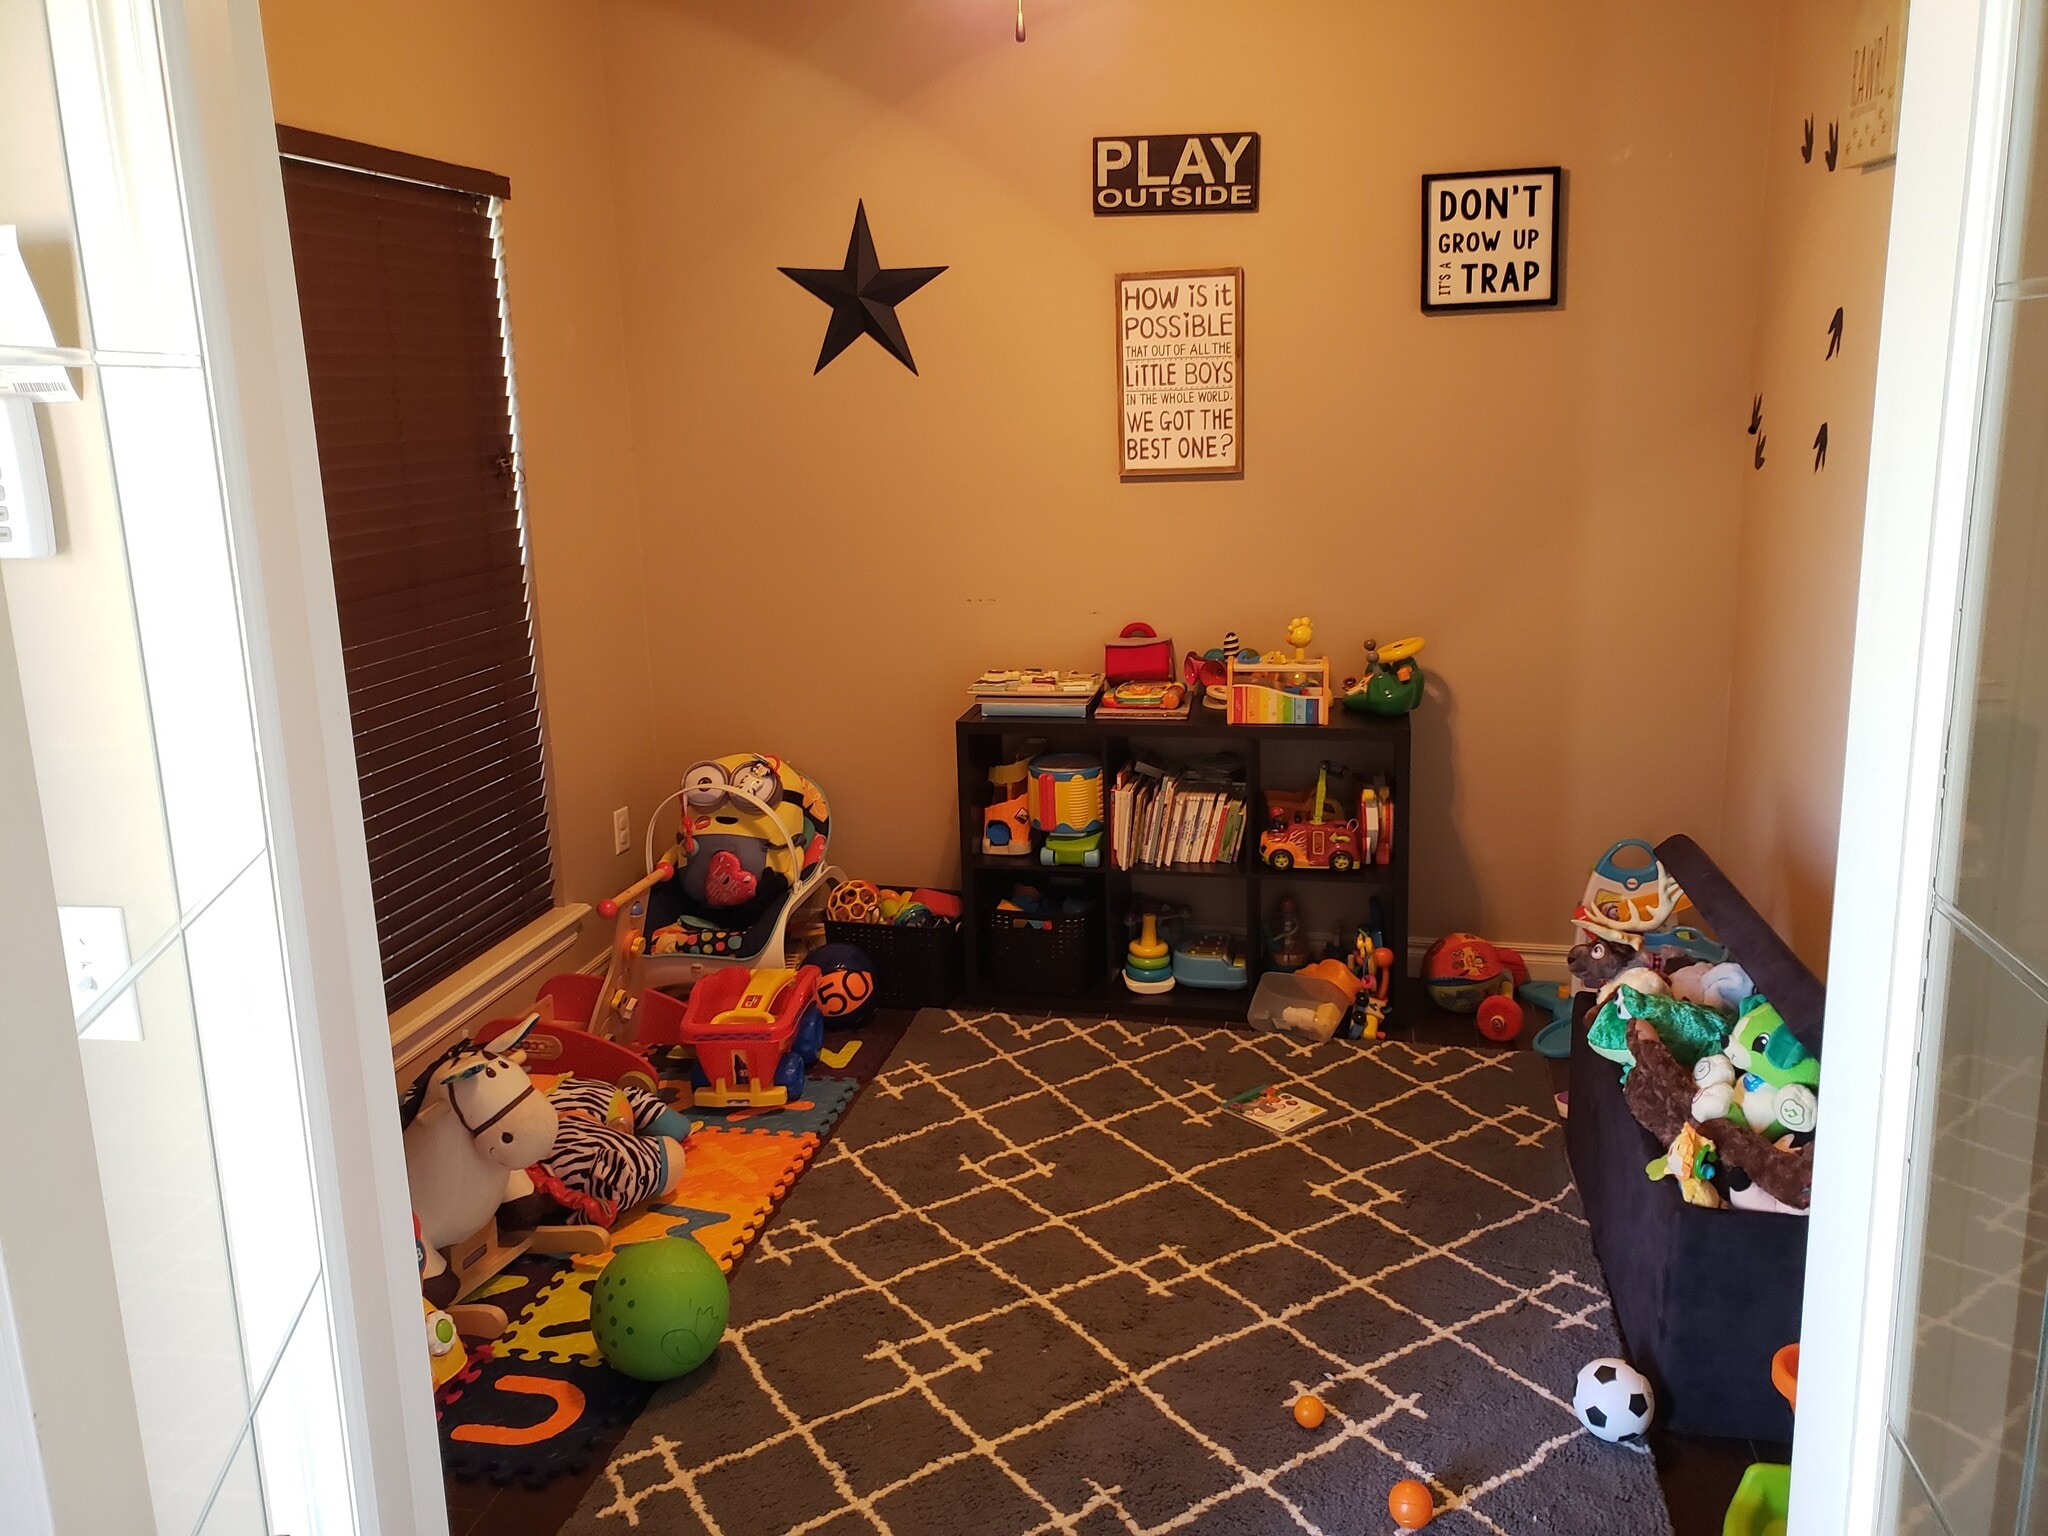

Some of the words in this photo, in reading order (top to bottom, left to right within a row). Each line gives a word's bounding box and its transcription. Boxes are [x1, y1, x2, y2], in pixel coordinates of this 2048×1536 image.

[1097, 135, 1253, 187] PLAY
[1097, 185, 1252, 208] OUTSIDE
[1440, 184, 1543, 222] DON'T
[1438, 230, 1501, 254] GROW
[1513, 229, 1540, 250] UP
[1438, 273, 1451, 296] IT'S
[1461, 261, 1540, 294] TRAP
[1124, 285, 1179, 311] HOW
[1125, 345, 1148, 358] THAT
[1151, 344, 1171, 357] OUT
[1173, 343, 1186, 356] OF
[1190, 342, 1210, 356] ALL
[1212, 341, 1232, 355] THE
[1185, 361, 1233, 385] BOYS
[1126, 394, 1136, 406] IN
[1140, 393, 1158, 405] THE
[1160, 391, 1194, 405] WHOLE
[1127, 411, 1154, 433] WE
[1160, 410, 1195, 431] GOT
[1200, 408, 1233, 430] THE
[1127, 437, 1172, 460] BEST
[1178, 433, 1234, 459] ONE?
[711, 864, 740, 897] LADIES
[818, 970, 870, 1015] 50
